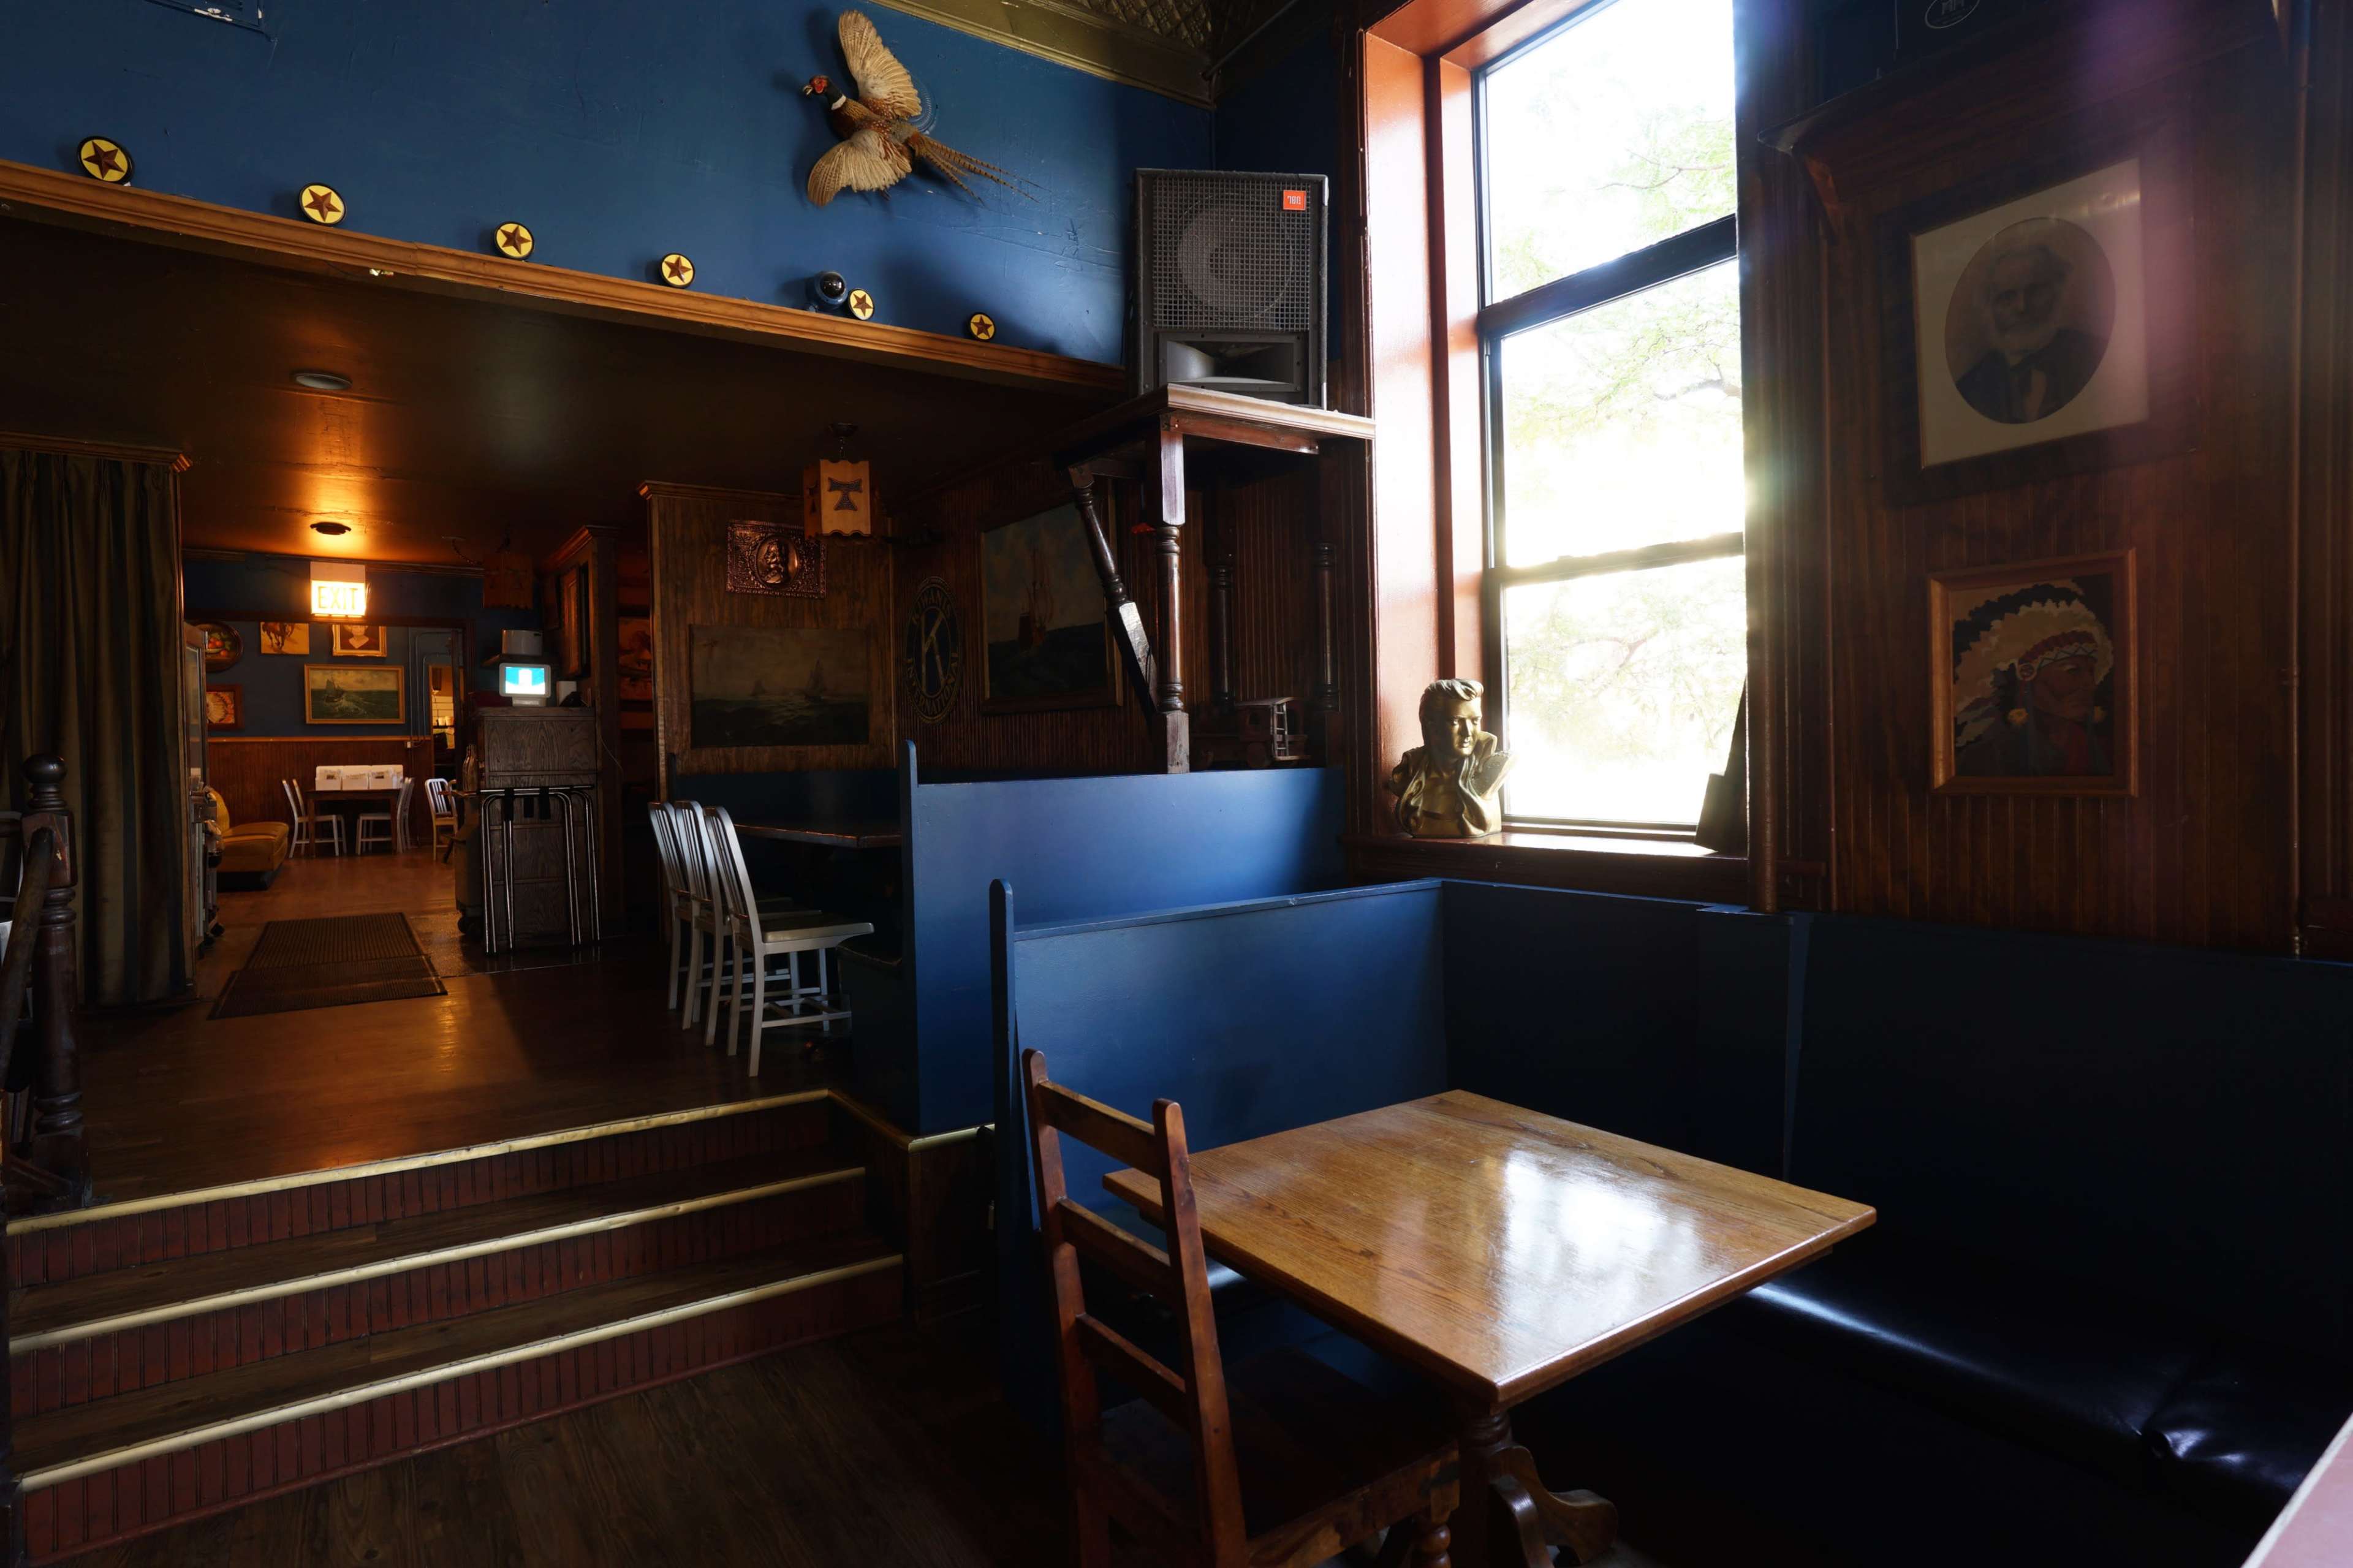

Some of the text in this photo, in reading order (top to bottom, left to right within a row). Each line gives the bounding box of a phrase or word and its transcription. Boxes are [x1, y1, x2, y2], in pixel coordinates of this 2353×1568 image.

[1287, 195, 1301, 205] JBL
[318, 586, 358, 610] EXIT
[921, 610, 944, 695] K
